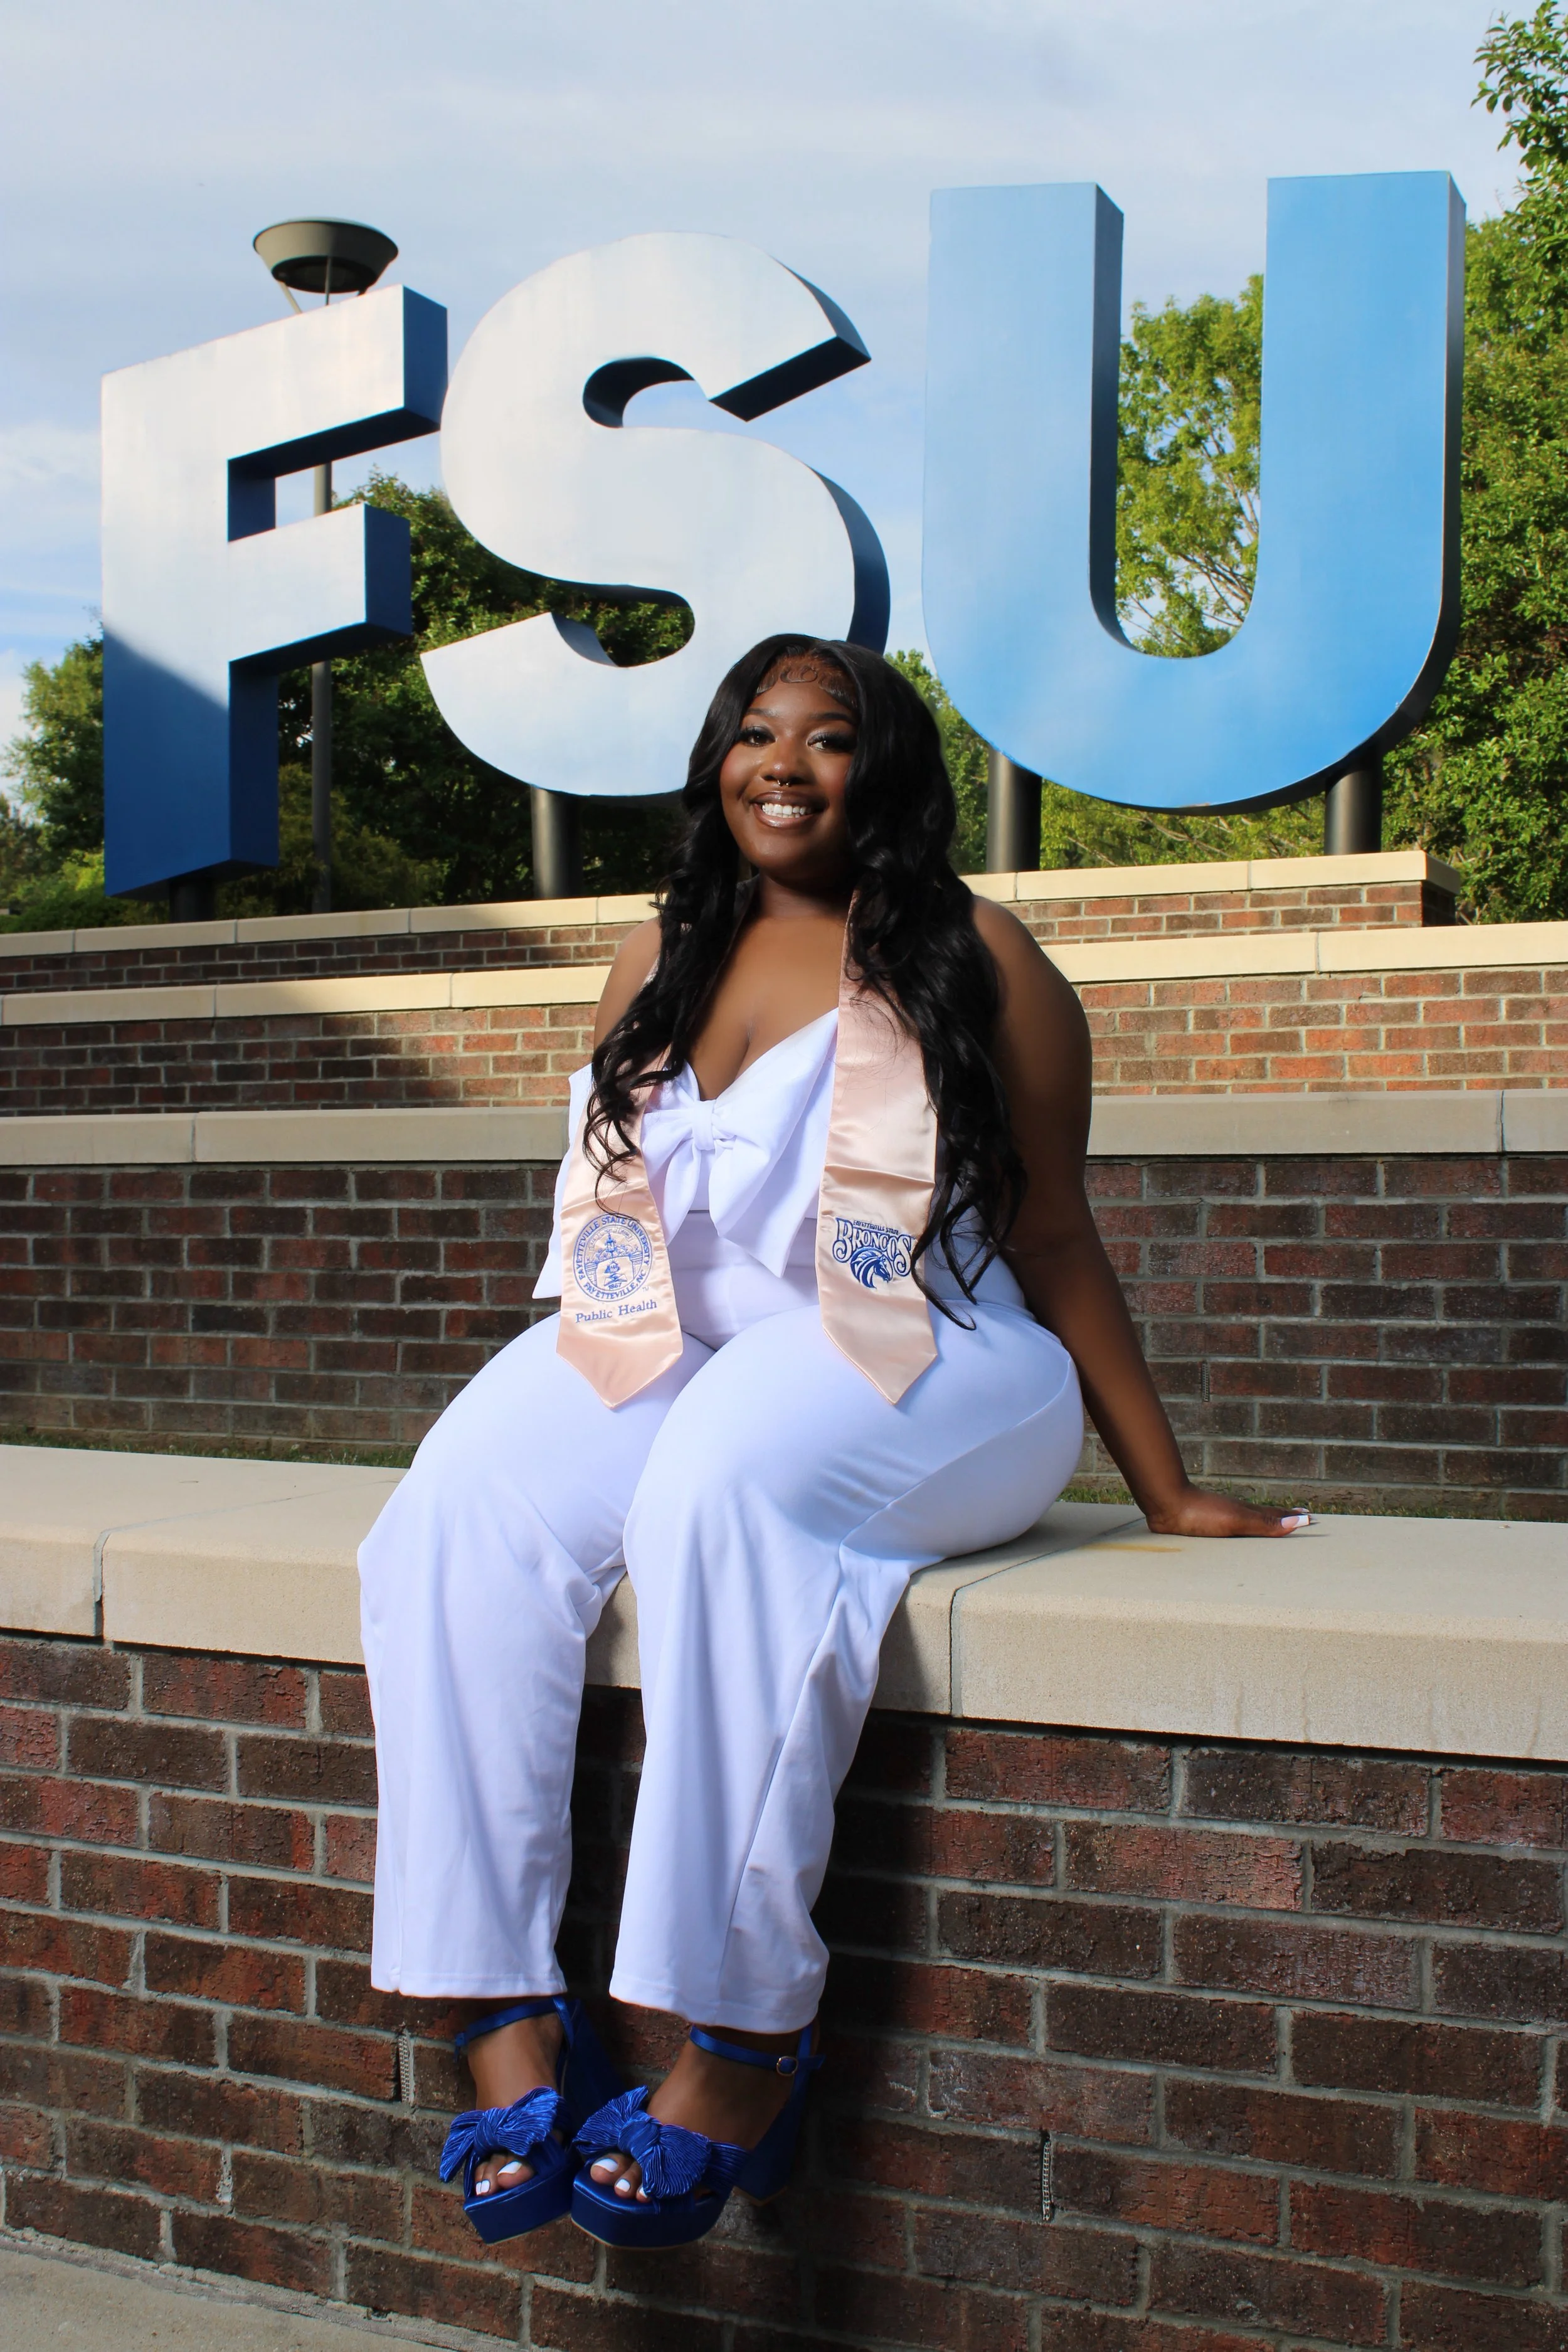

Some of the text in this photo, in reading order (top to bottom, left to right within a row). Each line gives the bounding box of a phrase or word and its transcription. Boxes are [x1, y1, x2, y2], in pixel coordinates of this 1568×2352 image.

[100, 171, 1466, 899] FSU
[576, 1221, 599, 1280] FAYETTEVILLE
[601, 1217, 627, 1226] STATE
[628, 1220, 650, 1266] UNIVERSITY
[832, 1217, 913, 1277] BRONCOS
[637, 1269, 647, 1286] NC
[576, 1299, 657, 1323] Public Health
